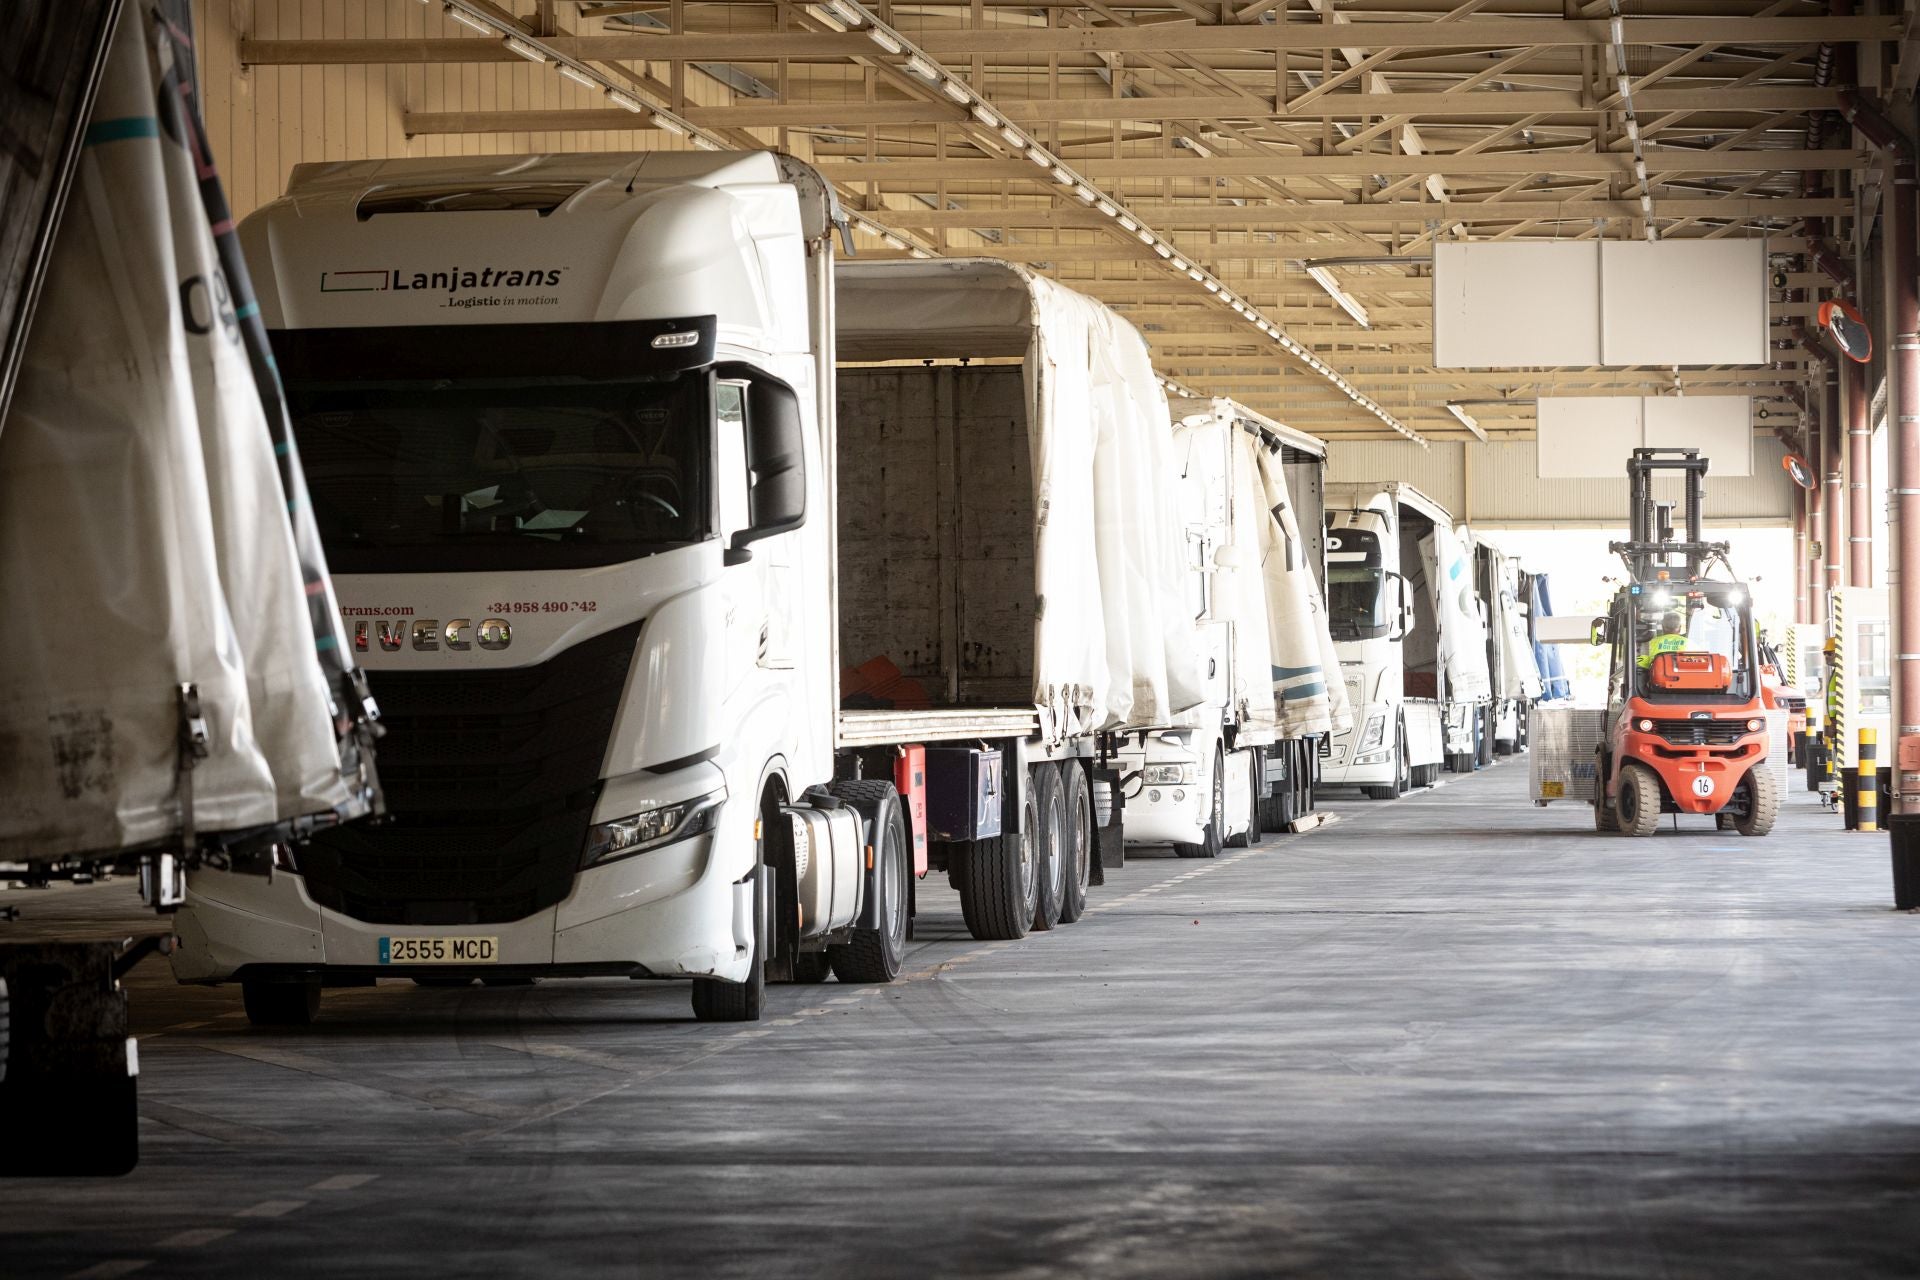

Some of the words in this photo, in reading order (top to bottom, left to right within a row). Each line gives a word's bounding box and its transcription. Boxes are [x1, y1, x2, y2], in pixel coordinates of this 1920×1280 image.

[393, 266, 561, 292] Lanjatrans
[449, 296, 500, 308] Logistic
[503, 296, 515, 306] in
[517, 296, 559, 306] motion
[487, 602, 511, 613] +34
[514, 602, 539, 613] 958
[542, 601, 568, 612] 490
[355, 618, 512, 652] IVECO
[1698, 779, 1709, 793] 16
[393, 940, 445, 959] 2555
[453, 940, 491, 959] MCD
